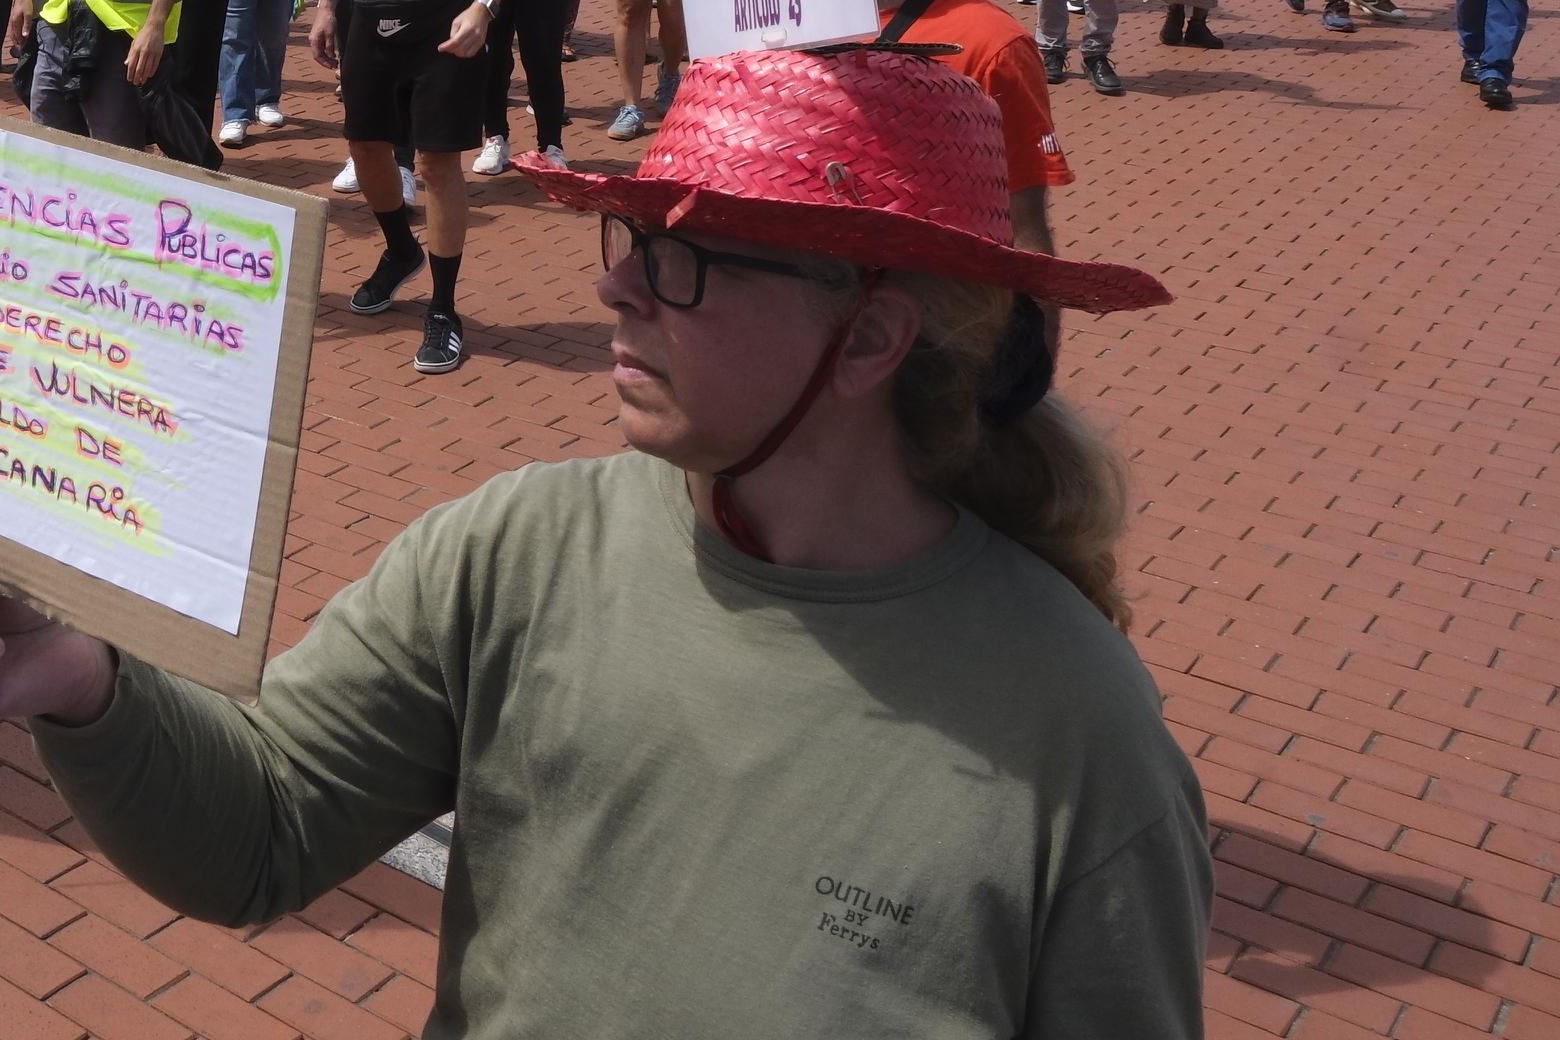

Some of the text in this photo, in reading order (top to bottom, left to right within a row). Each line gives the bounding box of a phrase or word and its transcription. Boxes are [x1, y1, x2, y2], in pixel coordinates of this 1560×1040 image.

[380, 19, 401, 30] NIKE
[34, 360, 175, 432] VULNERA
[77, 427, 122, 464] DE
[815, 876, 915, 925] OUTLINE
[844, 909, 869, 926] BY
[817, 912, 880, 949] Ferrys
